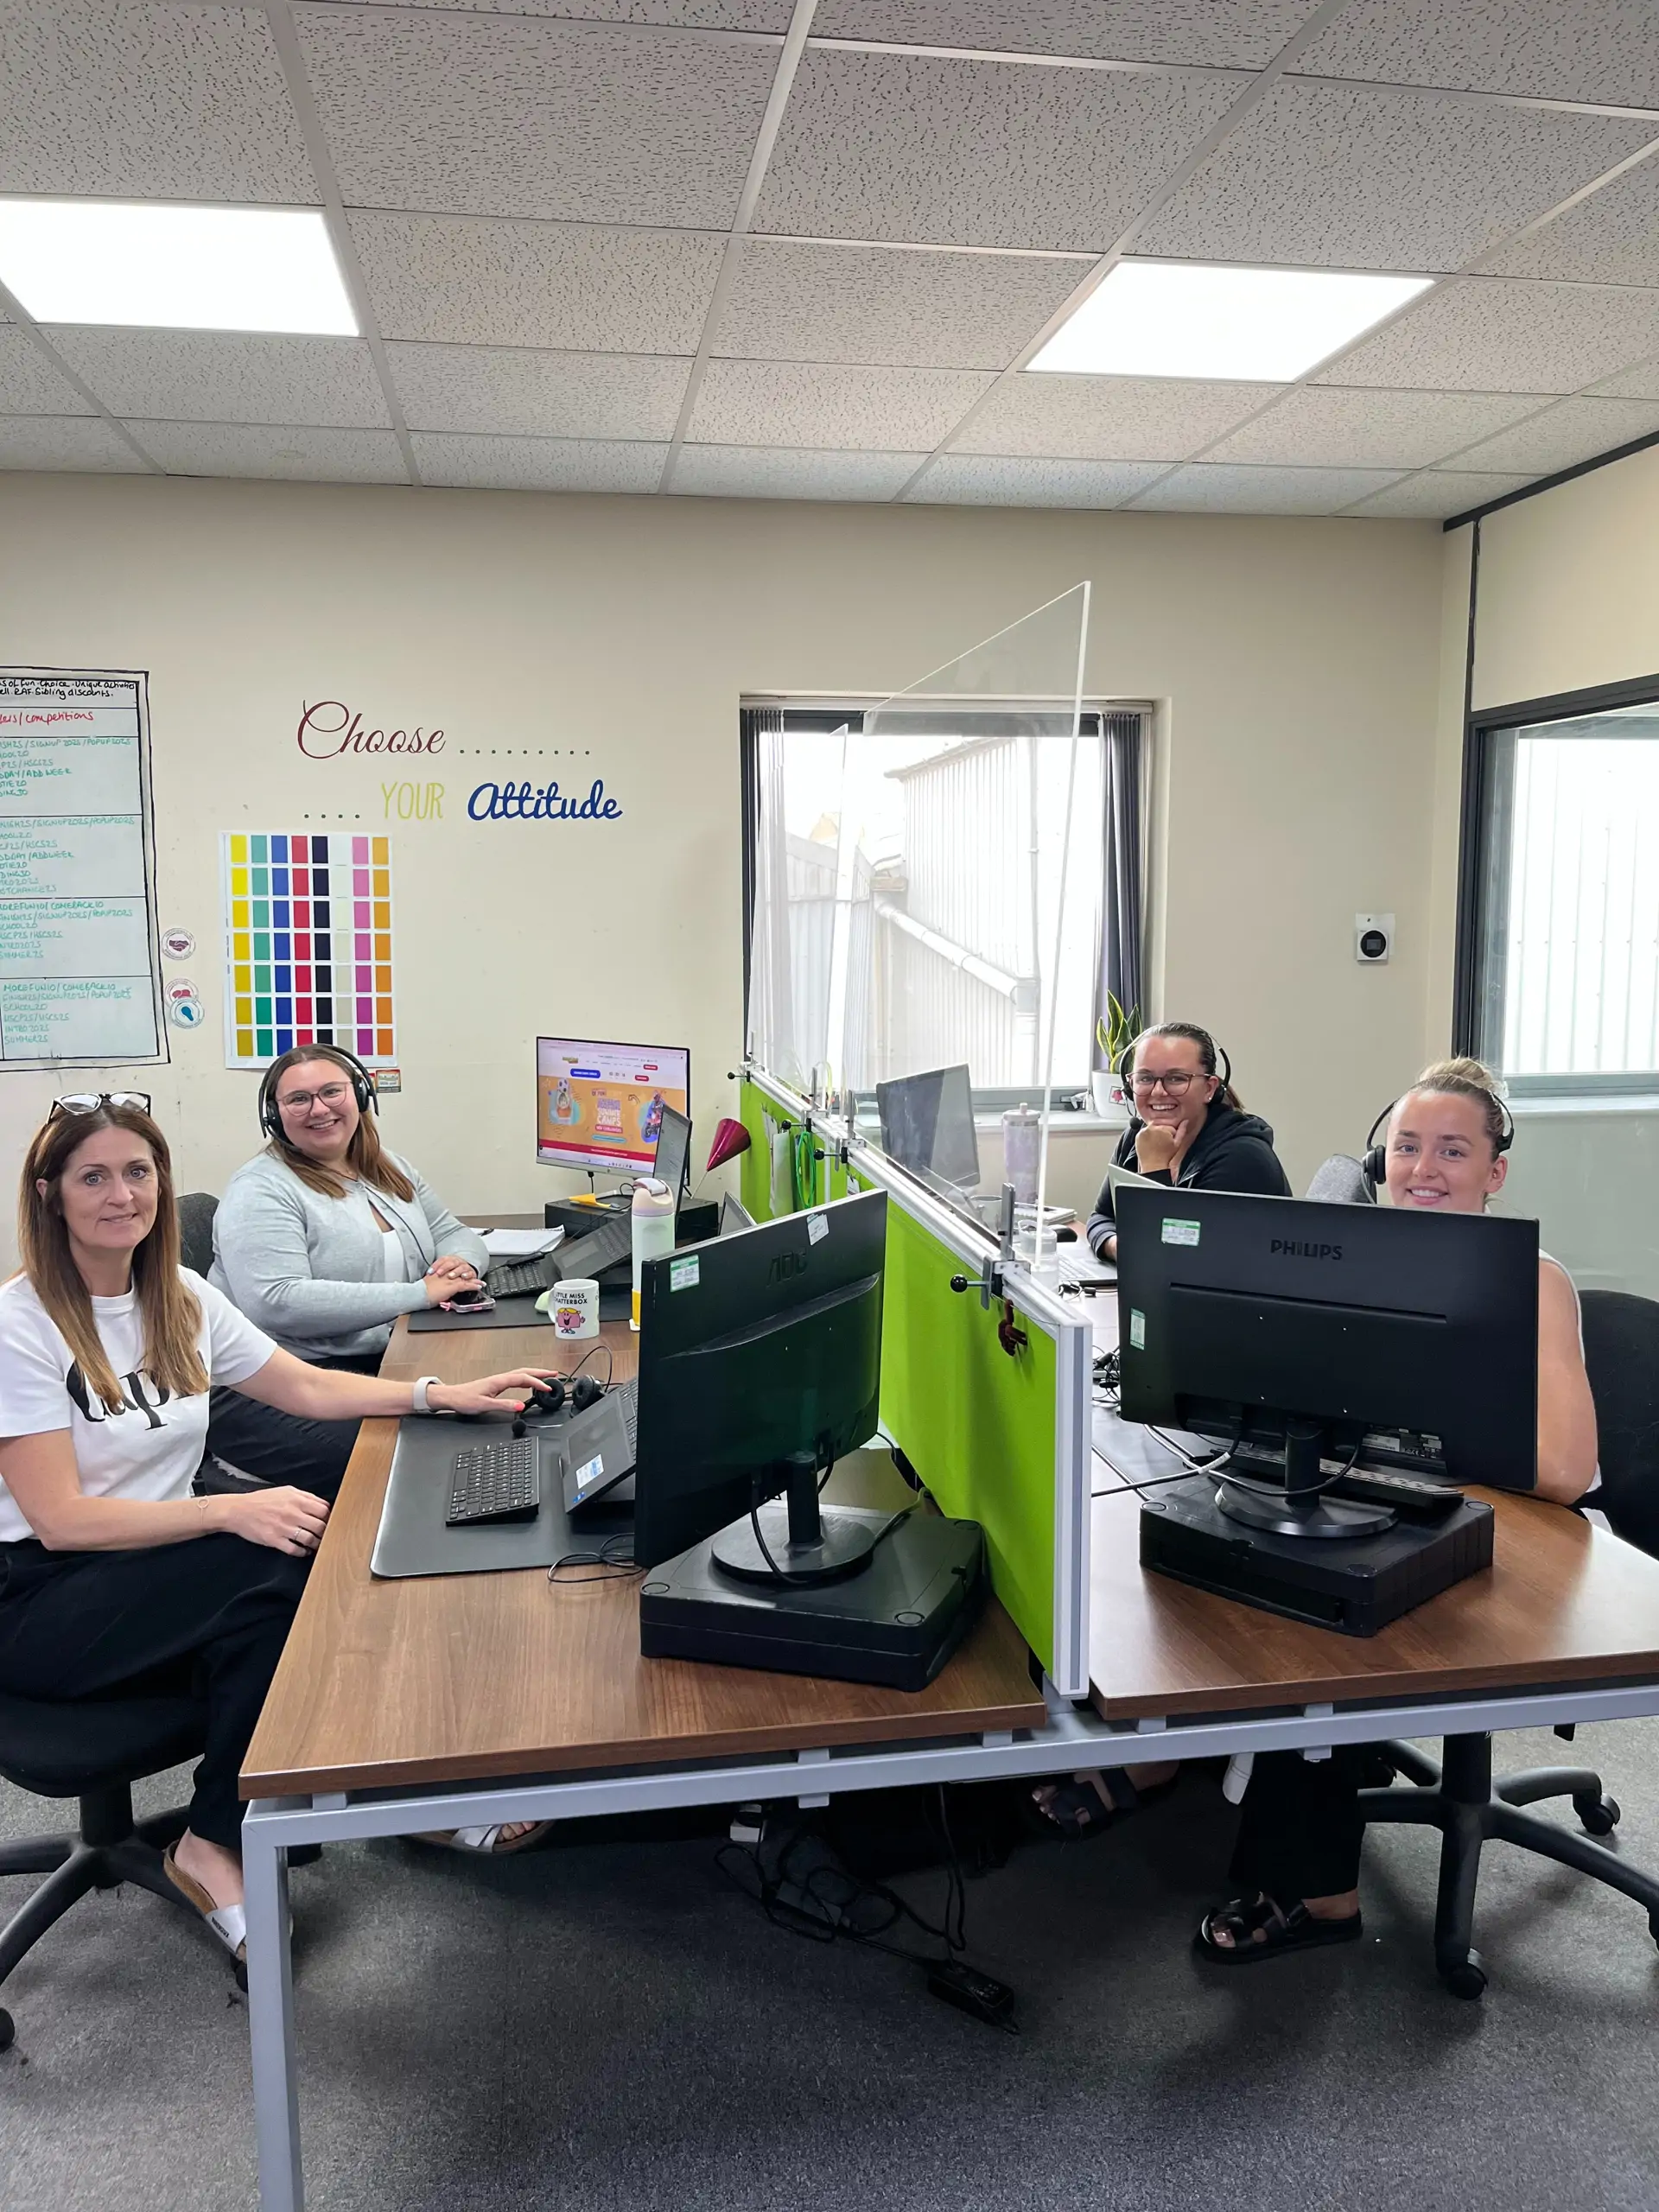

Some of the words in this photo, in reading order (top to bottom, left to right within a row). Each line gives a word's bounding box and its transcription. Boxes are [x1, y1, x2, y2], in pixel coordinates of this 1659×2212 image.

[297, 699, 446, 760] Choose
[380, 781, 446, 821] YOUR
[467, 779, 624, 822] Attitude
[1270, 1238, 1344, 1261] PHILIPS
